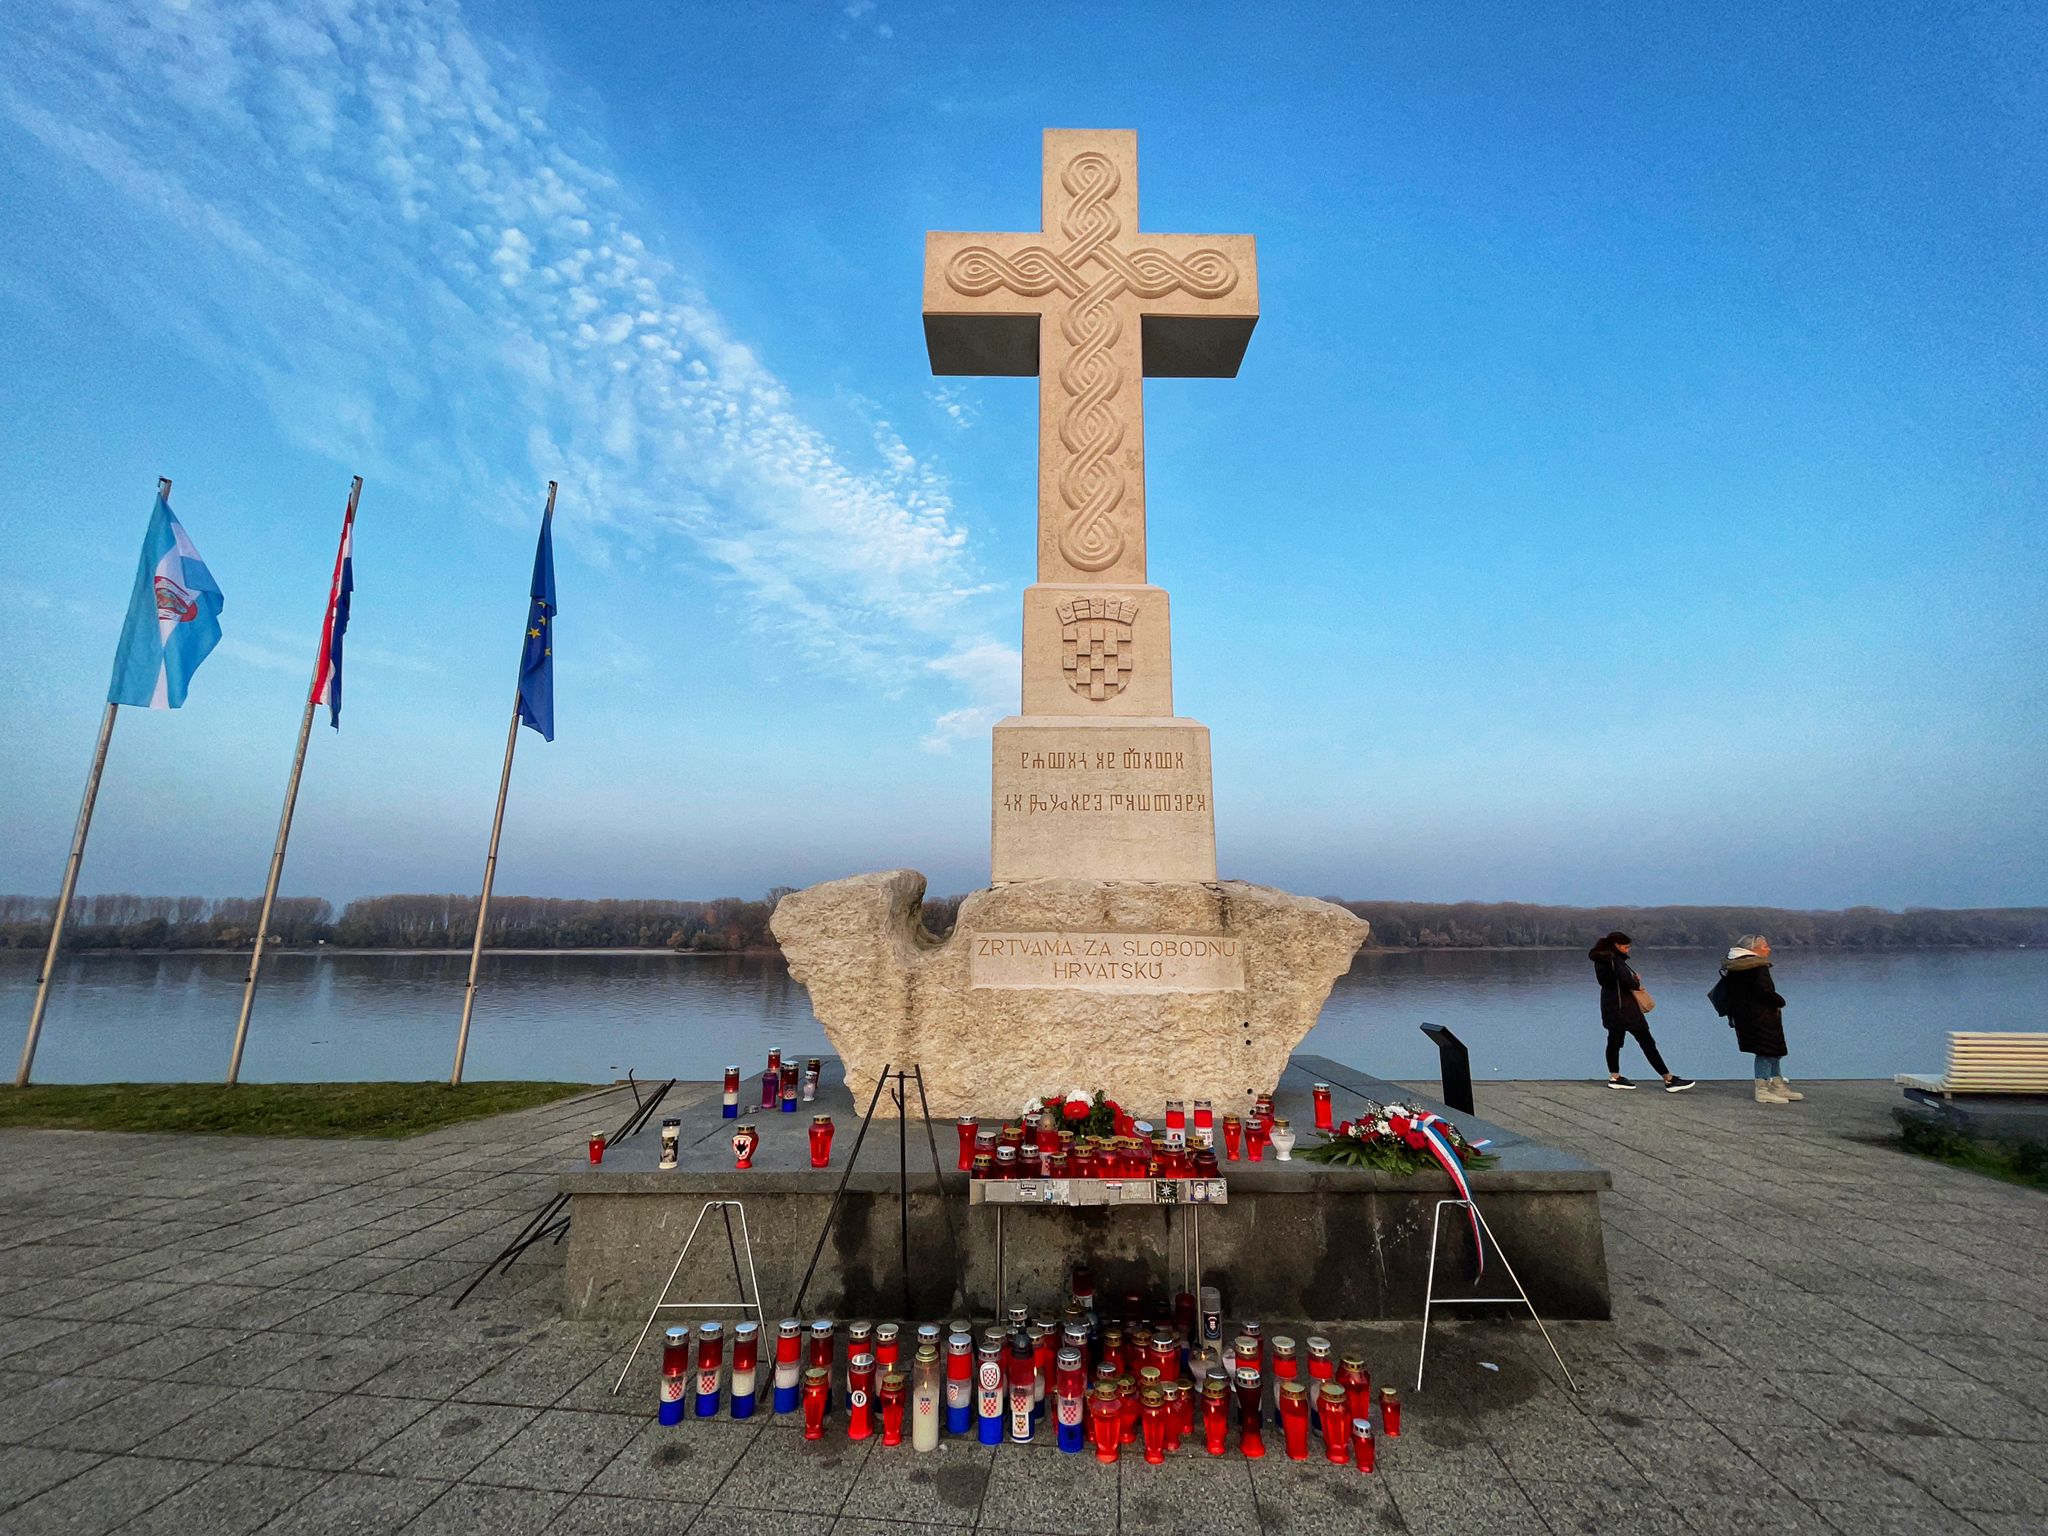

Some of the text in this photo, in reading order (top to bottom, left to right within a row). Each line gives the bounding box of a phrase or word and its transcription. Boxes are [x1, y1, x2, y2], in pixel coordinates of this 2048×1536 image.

[1083, 938, 1112, 957] ZA
[1123, 940, 1236, 958] SLOBODNU
[1053, 961, 1163, 980] HRVATSKU
